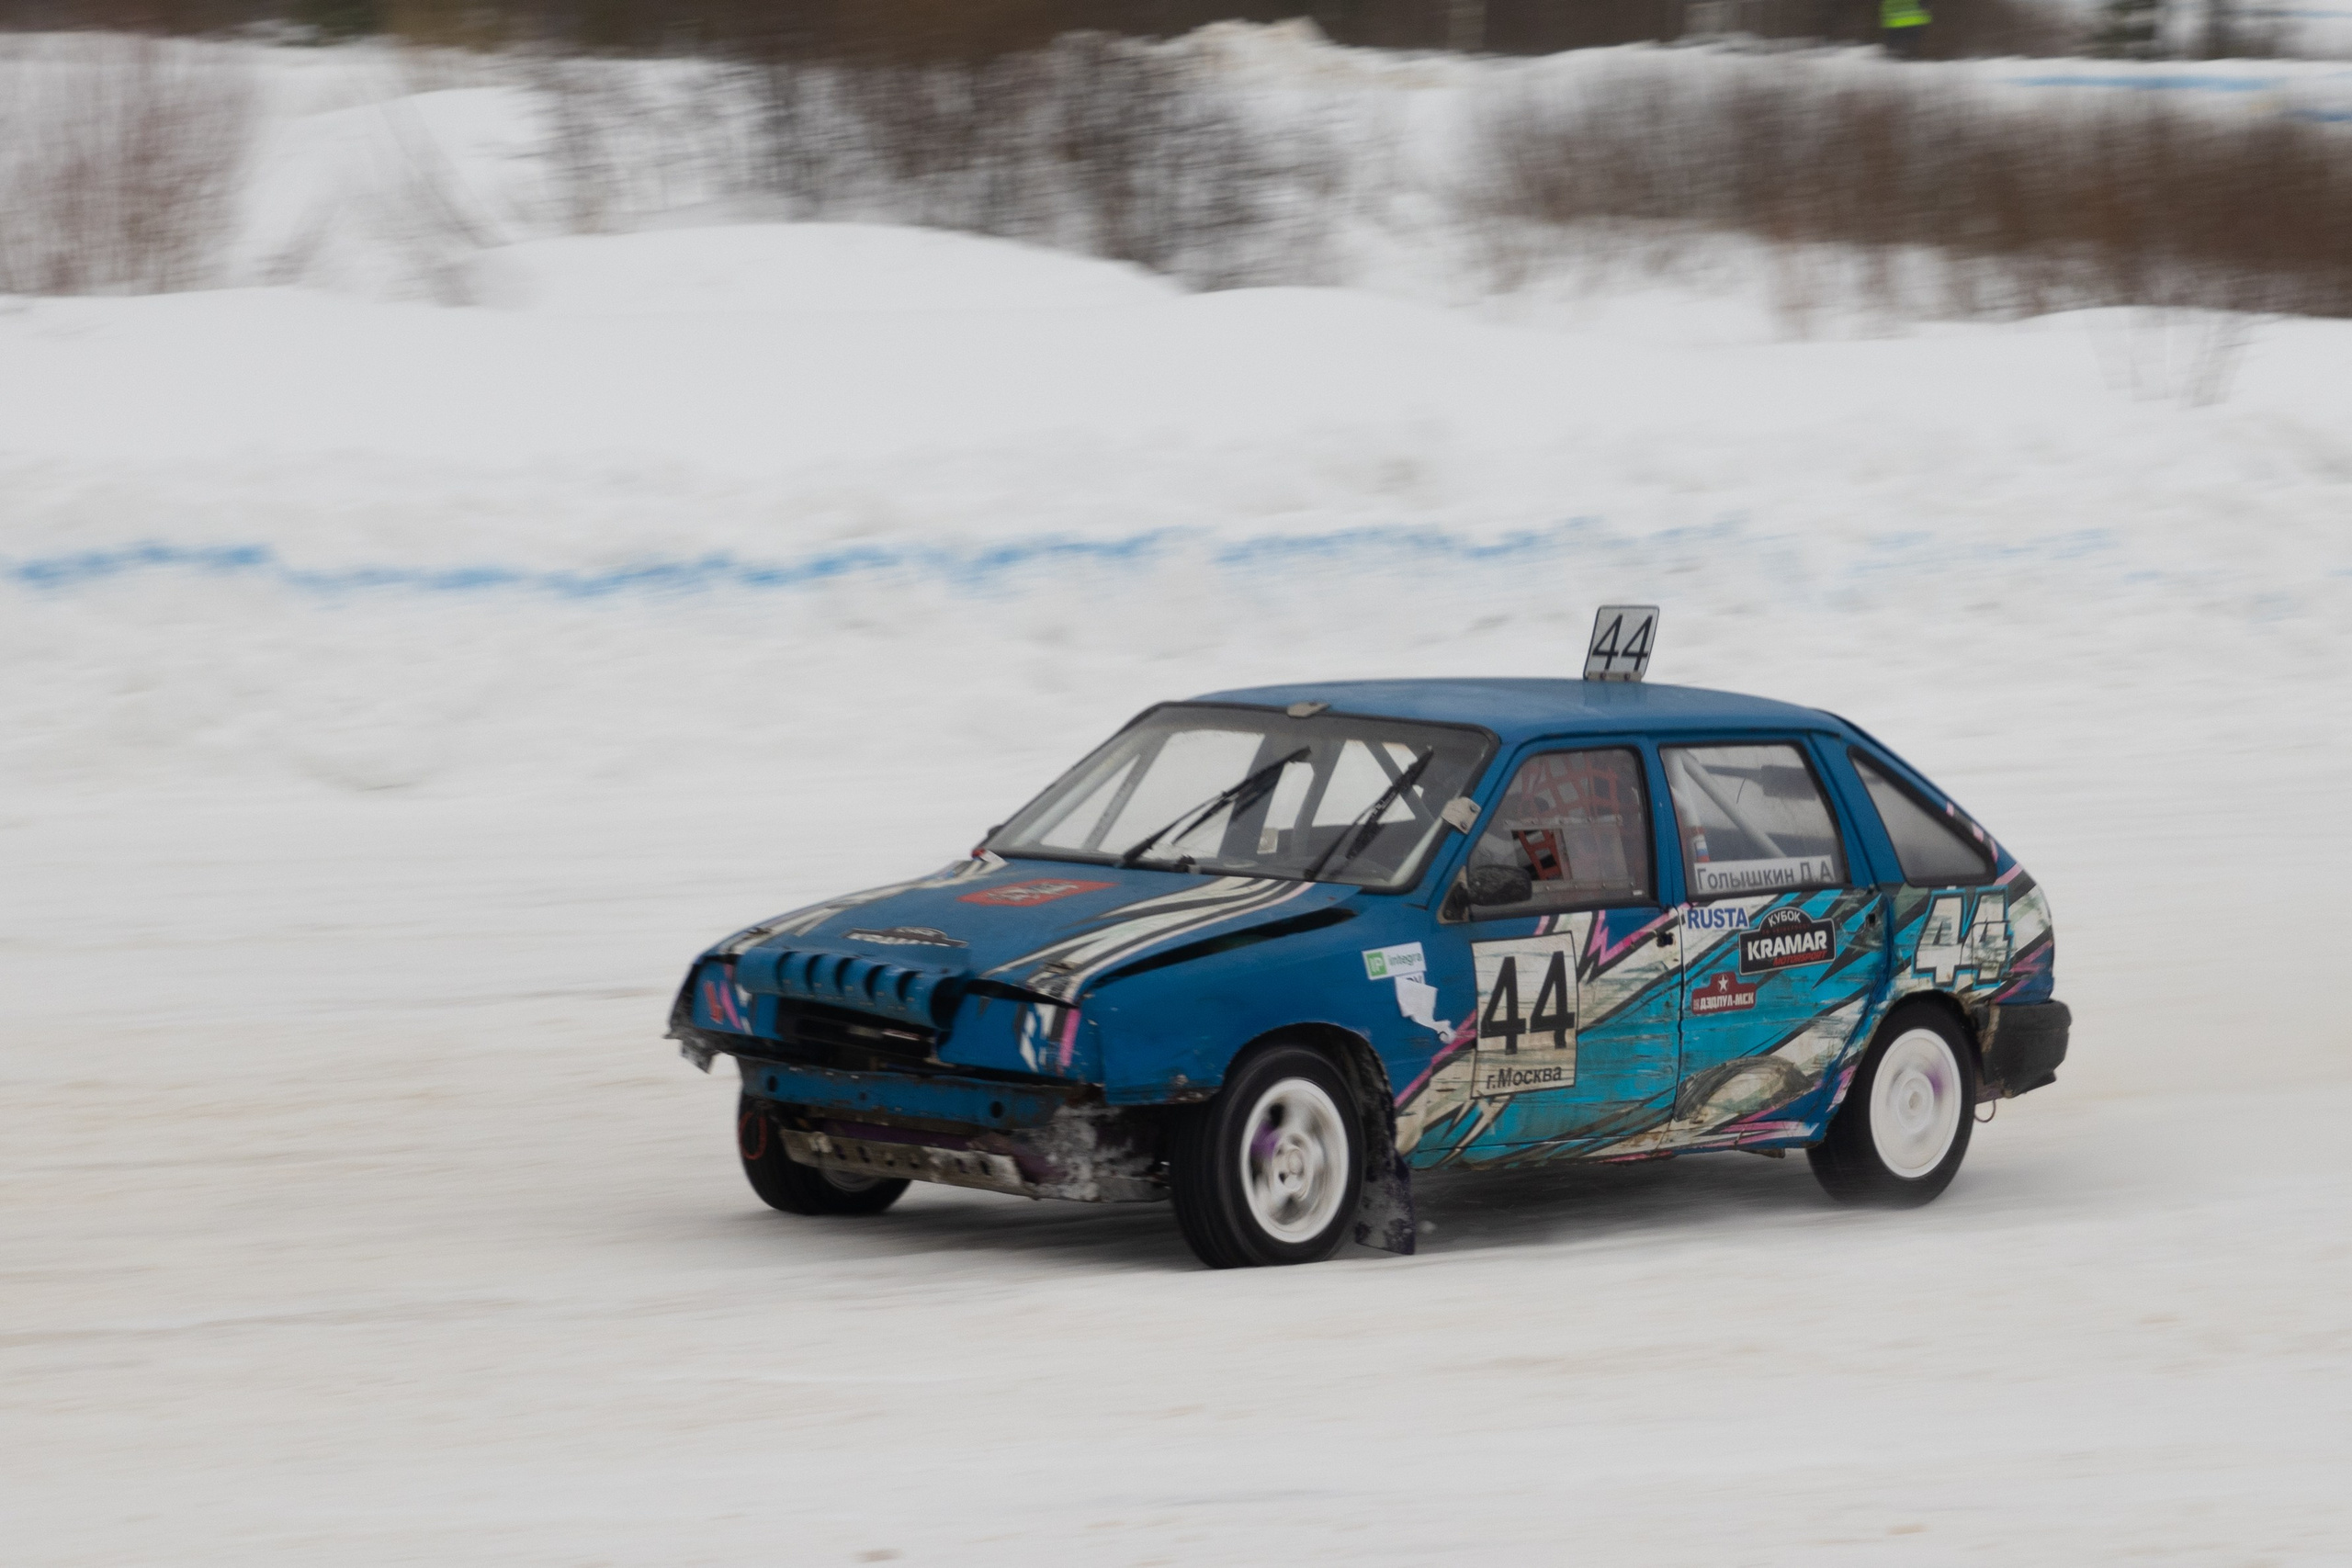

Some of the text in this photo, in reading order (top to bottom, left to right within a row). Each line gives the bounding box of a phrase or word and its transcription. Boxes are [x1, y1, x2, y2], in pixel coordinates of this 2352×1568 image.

[1592, 613, 1653, 671] 44
[1697, 867, 1794, 889] Голышкин
[1687, 908, 1747, 929] RUSTA
[1768, 910, 1801, 927] КУБОК
[1747, 931, 1826, 961] KRAMAR
[1912, 886, 2013, 989] 44
[1773, 951, 1827, 966] MOTORSPORT
[1480, 951, 1575, 1055] 44
[1487, 1066, 1563, 1089] г.Москва
